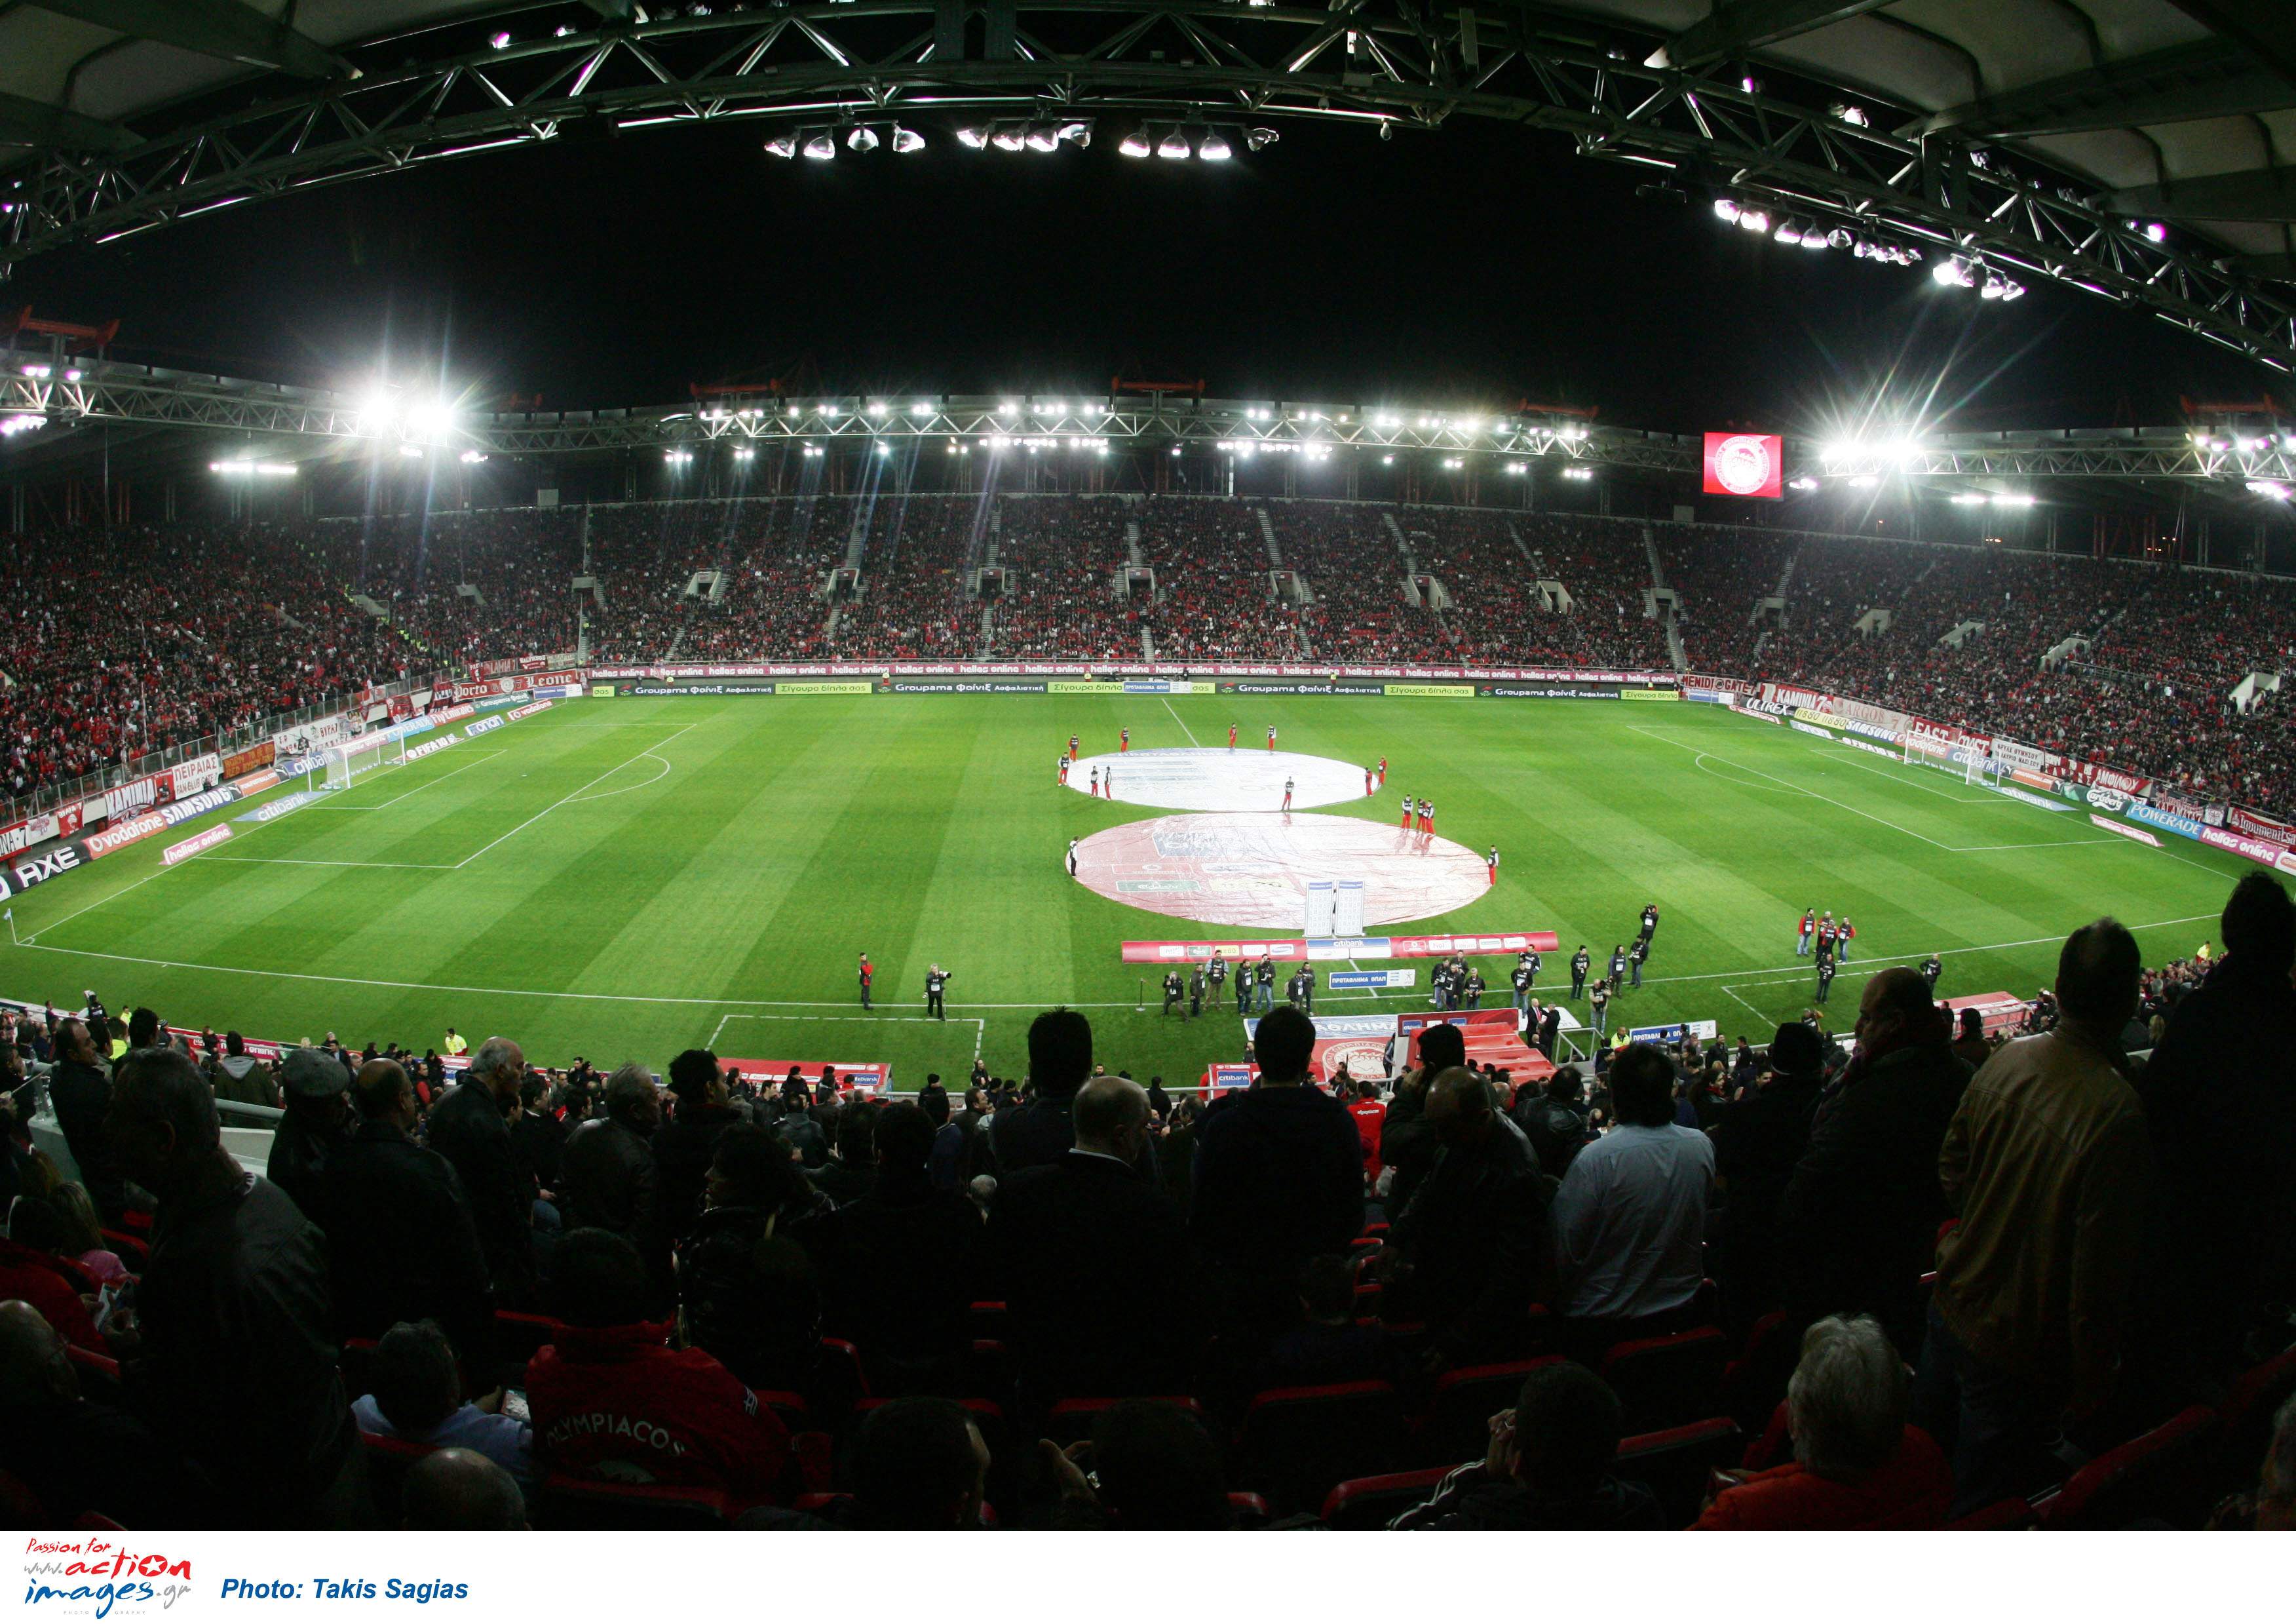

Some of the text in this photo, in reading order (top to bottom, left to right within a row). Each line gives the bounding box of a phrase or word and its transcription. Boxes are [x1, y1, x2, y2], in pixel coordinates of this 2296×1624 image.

[678, 668, 704, 676] online
[708, 667, 764, 676] hellas online
[769, 667, 826, 675] hellas online
[832, 666, 890, 674] hellas online
[1219, 666, 1278, 674] hellas online
[1283, 667, 1340, 675] hellas online
[1345, 667, 1401, 676] hellas online
[1406, 668, 1459, 677] hellas online
[1464, 669, 1516, 678] hellas online
[1520, 670, 1545, 679] hellas
[524, 674, 572, 688] Leone
[1575, 672, 1623, 682] hellas online
[1627, 674, 1649, 682] hellas
[635, 686, 687, 695] Groupama
[895, 684, 953, 693] Groupama
[1054, 684, 1094, 692] Σίγουρα
[1238, 684, 1295, 693] Groupama
[1390, 686, 1426, 695] Σίγουρα
[1495, 688, 1545, 697] Groupama
[1776, 688, 1817, 710] KAMINIA
[1846, 719, 1898, 742] SAMSUNG
[174, 756, 217, 782] ΠΕΙΡΑΙΑΣ
[161, 787, 231, 826] SAMSUNG
[2130, 803, 2202, 835] POWERADE
[102, 814, 164, 848] vodafone
[201, 826, 231, 847] online
[2202, 827, 2238, 848] hellas
[2239, 841, 2275, 862] online
[15, 845, 80, 888] AXE
[1333, 939, 1364, 948] citibank
[1217, 1073, 1249, 1082] citibank
